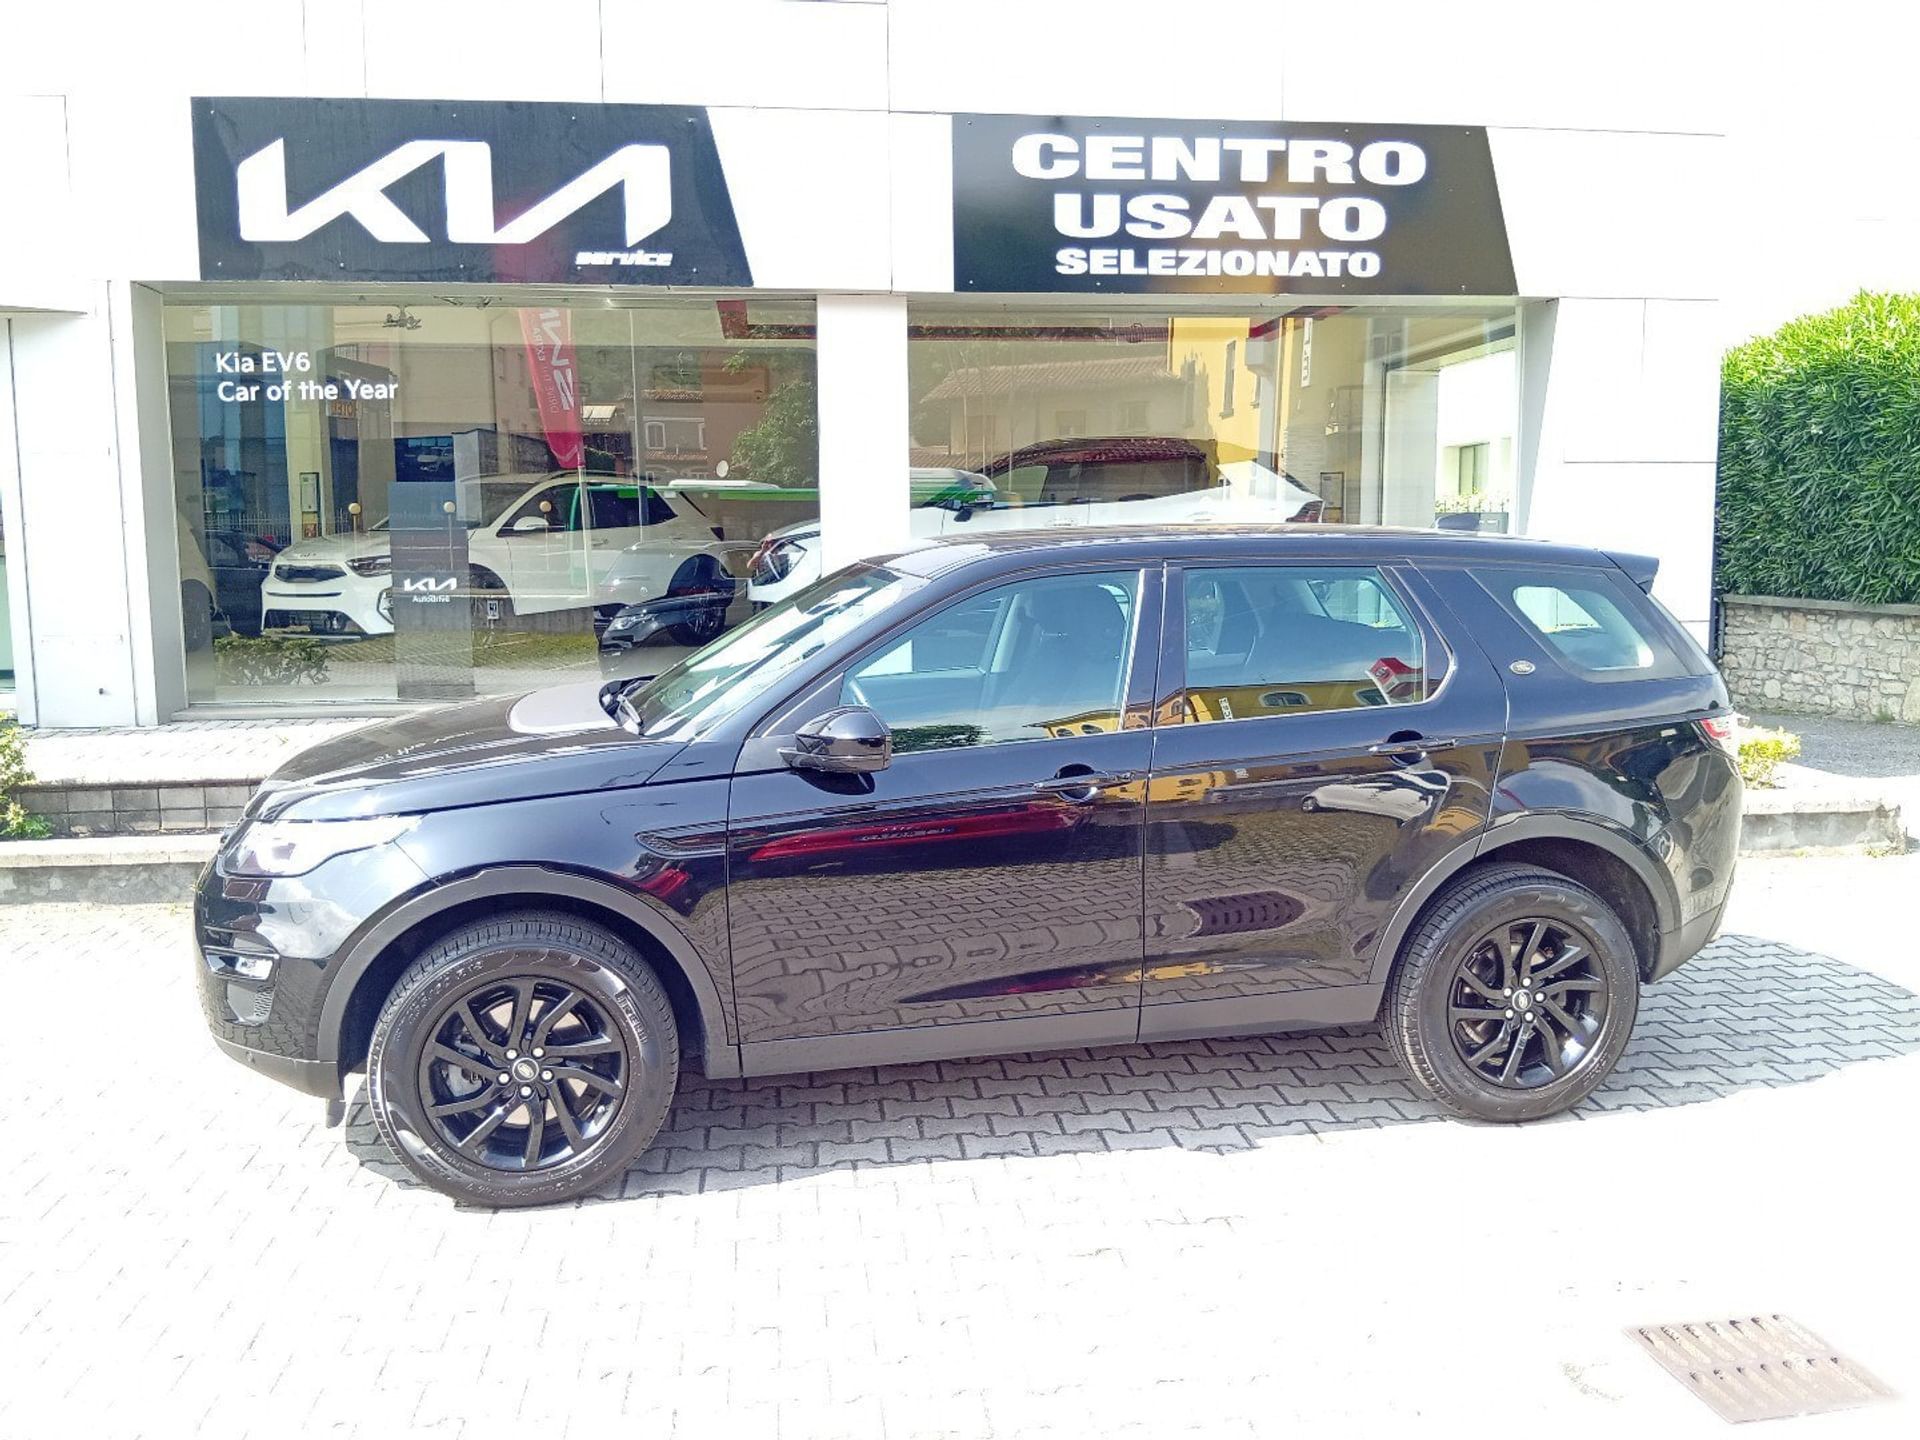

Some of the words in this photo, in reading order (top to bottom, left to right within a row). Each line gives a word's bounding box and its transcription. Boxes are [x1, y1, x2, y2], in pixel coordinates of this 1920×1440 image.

[1011, 133, 1427, 186] CENTRO
[237, 138, 672, 248] KIA
[1054, 193, 1387, 242] USATO
[575, 249, 673, 266] service
[1055, 247, 1381, 278] SELEZIONATO
[215, 352, 255, 373] Kia
[262, 351, 311, 373] EV6
[217, 380, 260, 402] Car
[266, 380, 292, 401] of
[297, 379, 338, 400] the
[344, 379, 399, 400] Year
[403, 577, 458, 592] KIA
